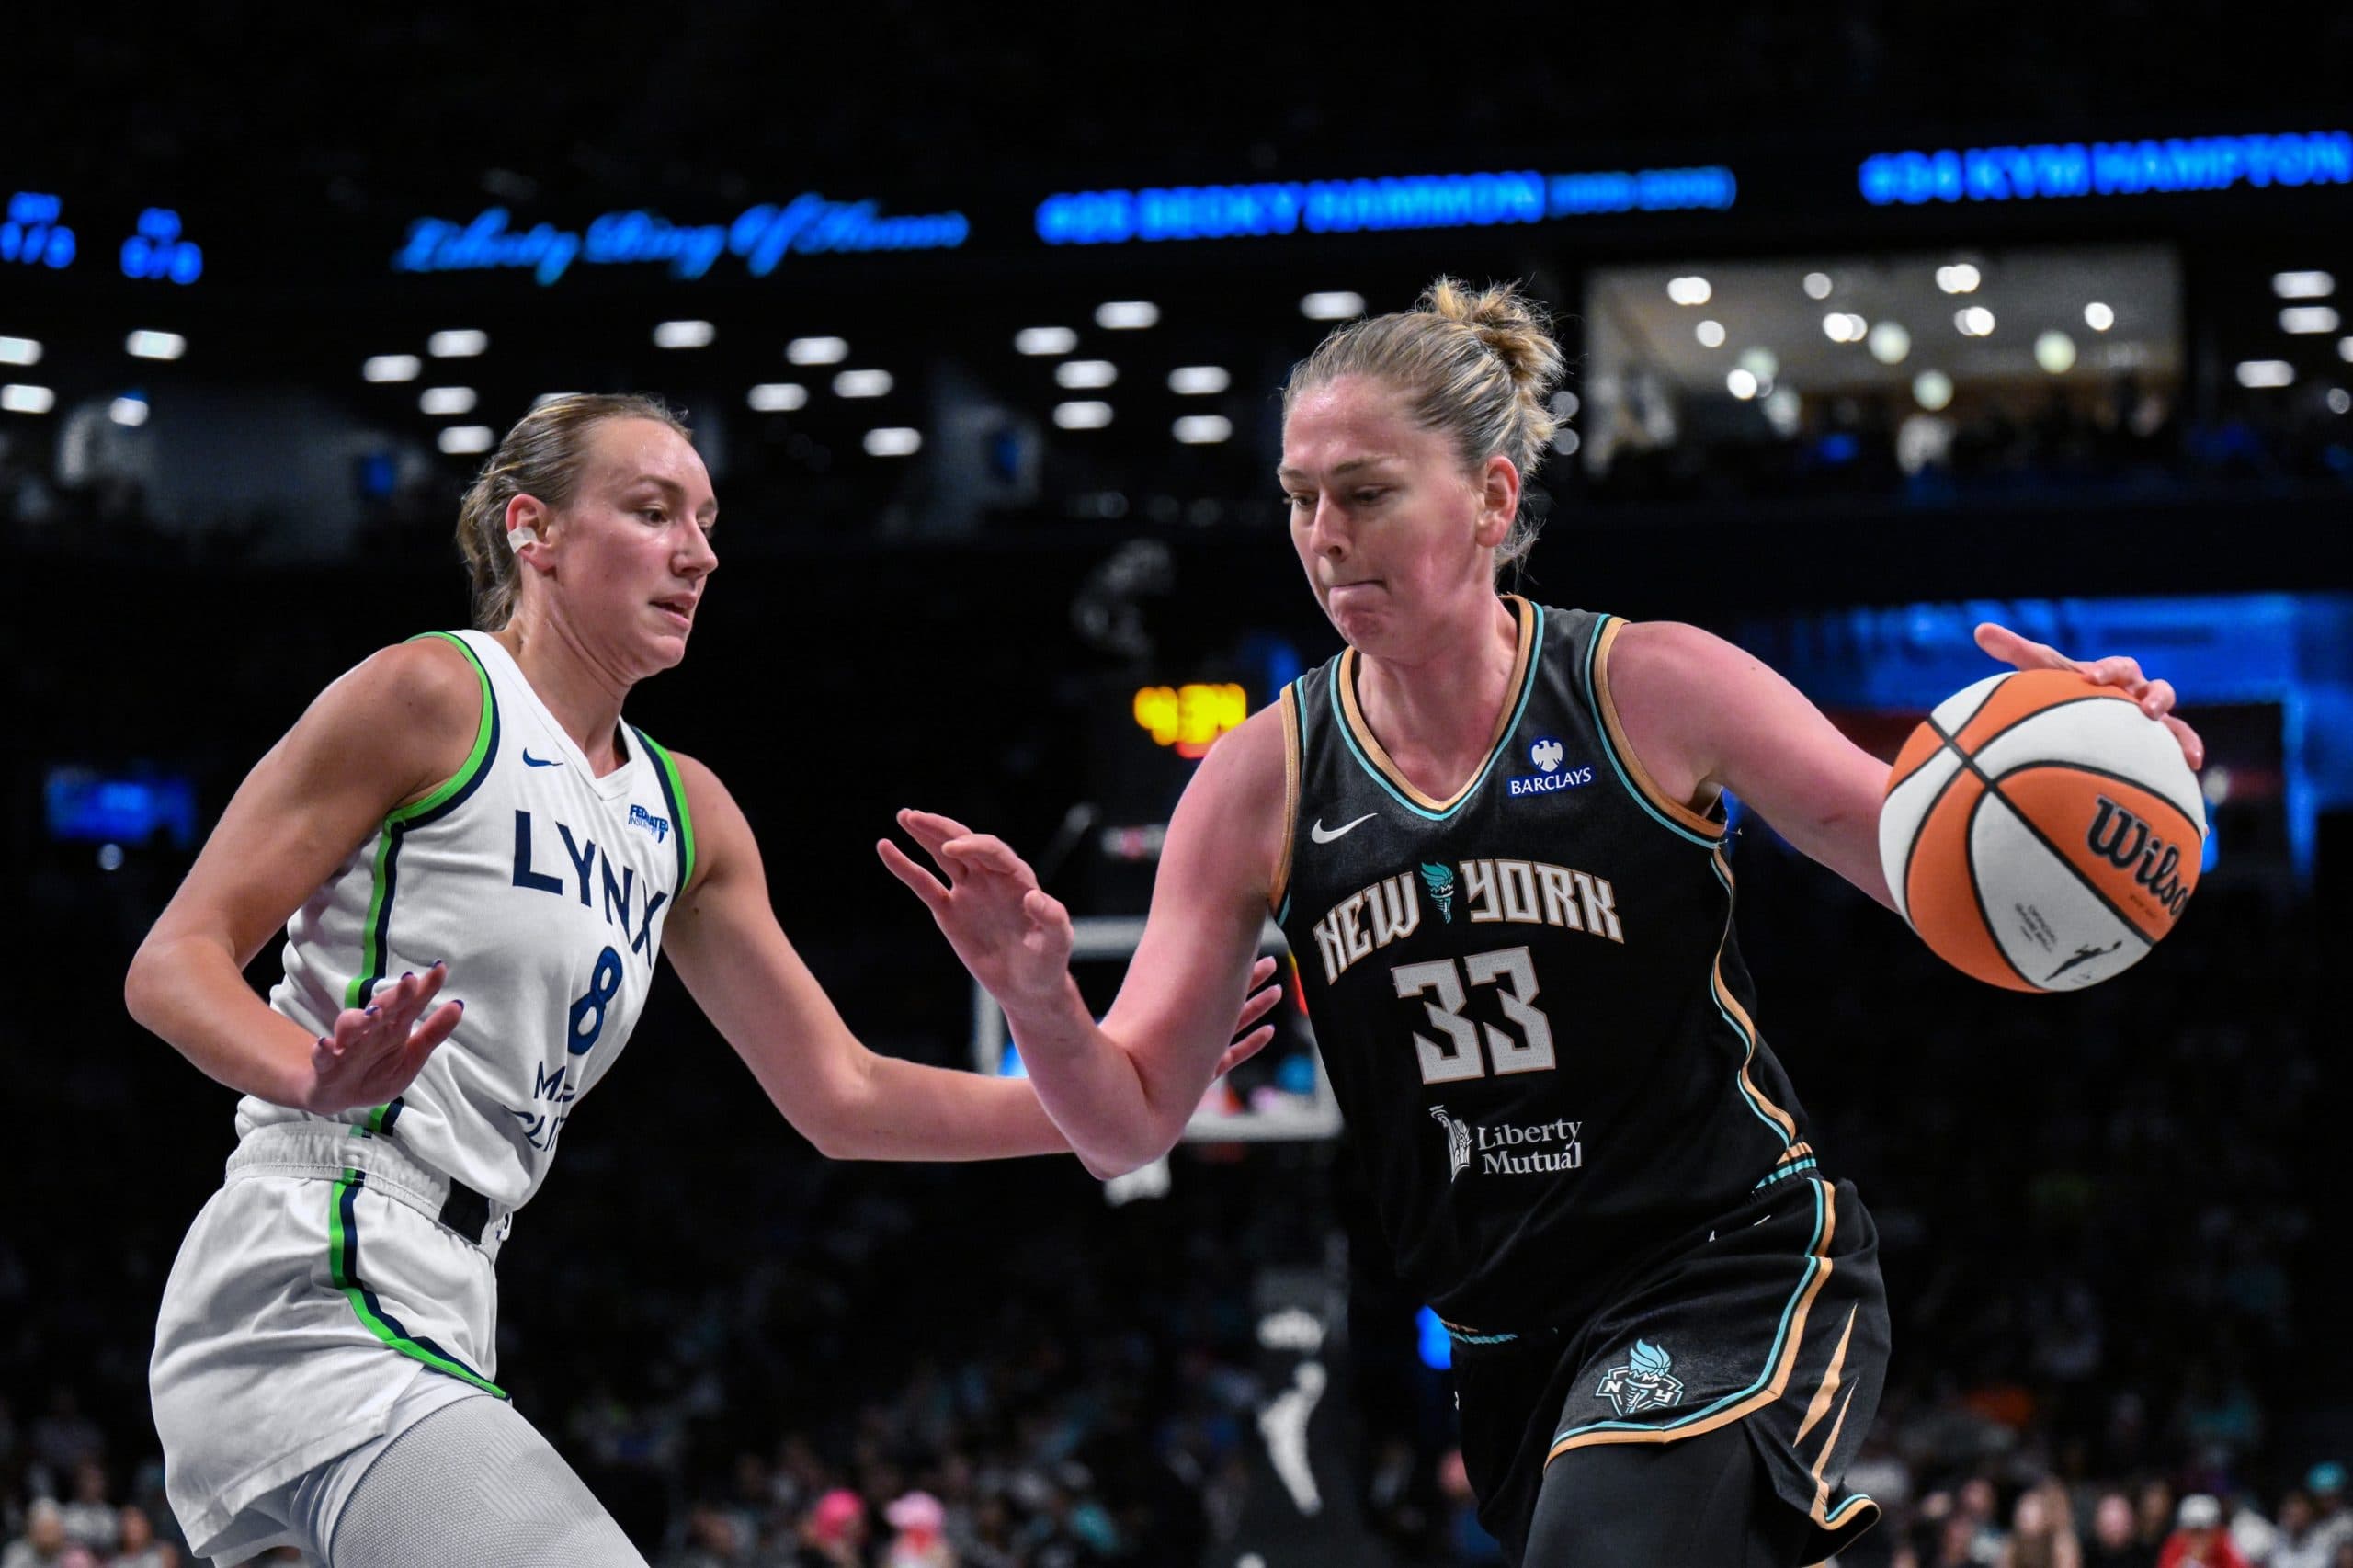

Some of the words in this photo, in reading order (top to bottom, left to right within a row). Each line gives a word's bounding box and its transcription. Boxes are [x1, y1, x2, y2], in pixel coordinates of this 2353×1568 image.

[1510, 767, 1592, 795] BARCLAYS
[512, 809, 668, 971] LYNX
[2086, 796, 2188, 916] Wilso
[1313, 871, 1420, 986] NEW
[1459, 858, 1625, 945] YORK
[567, 945, 623, 1056] 8
[1390, 945, 1557, 1085] 33
[1477, 1118, 1583, 1151] Liberty
[1482, 1142, 1583, 1175] Mutual
[1603, 1381, 1623, 1392] N
